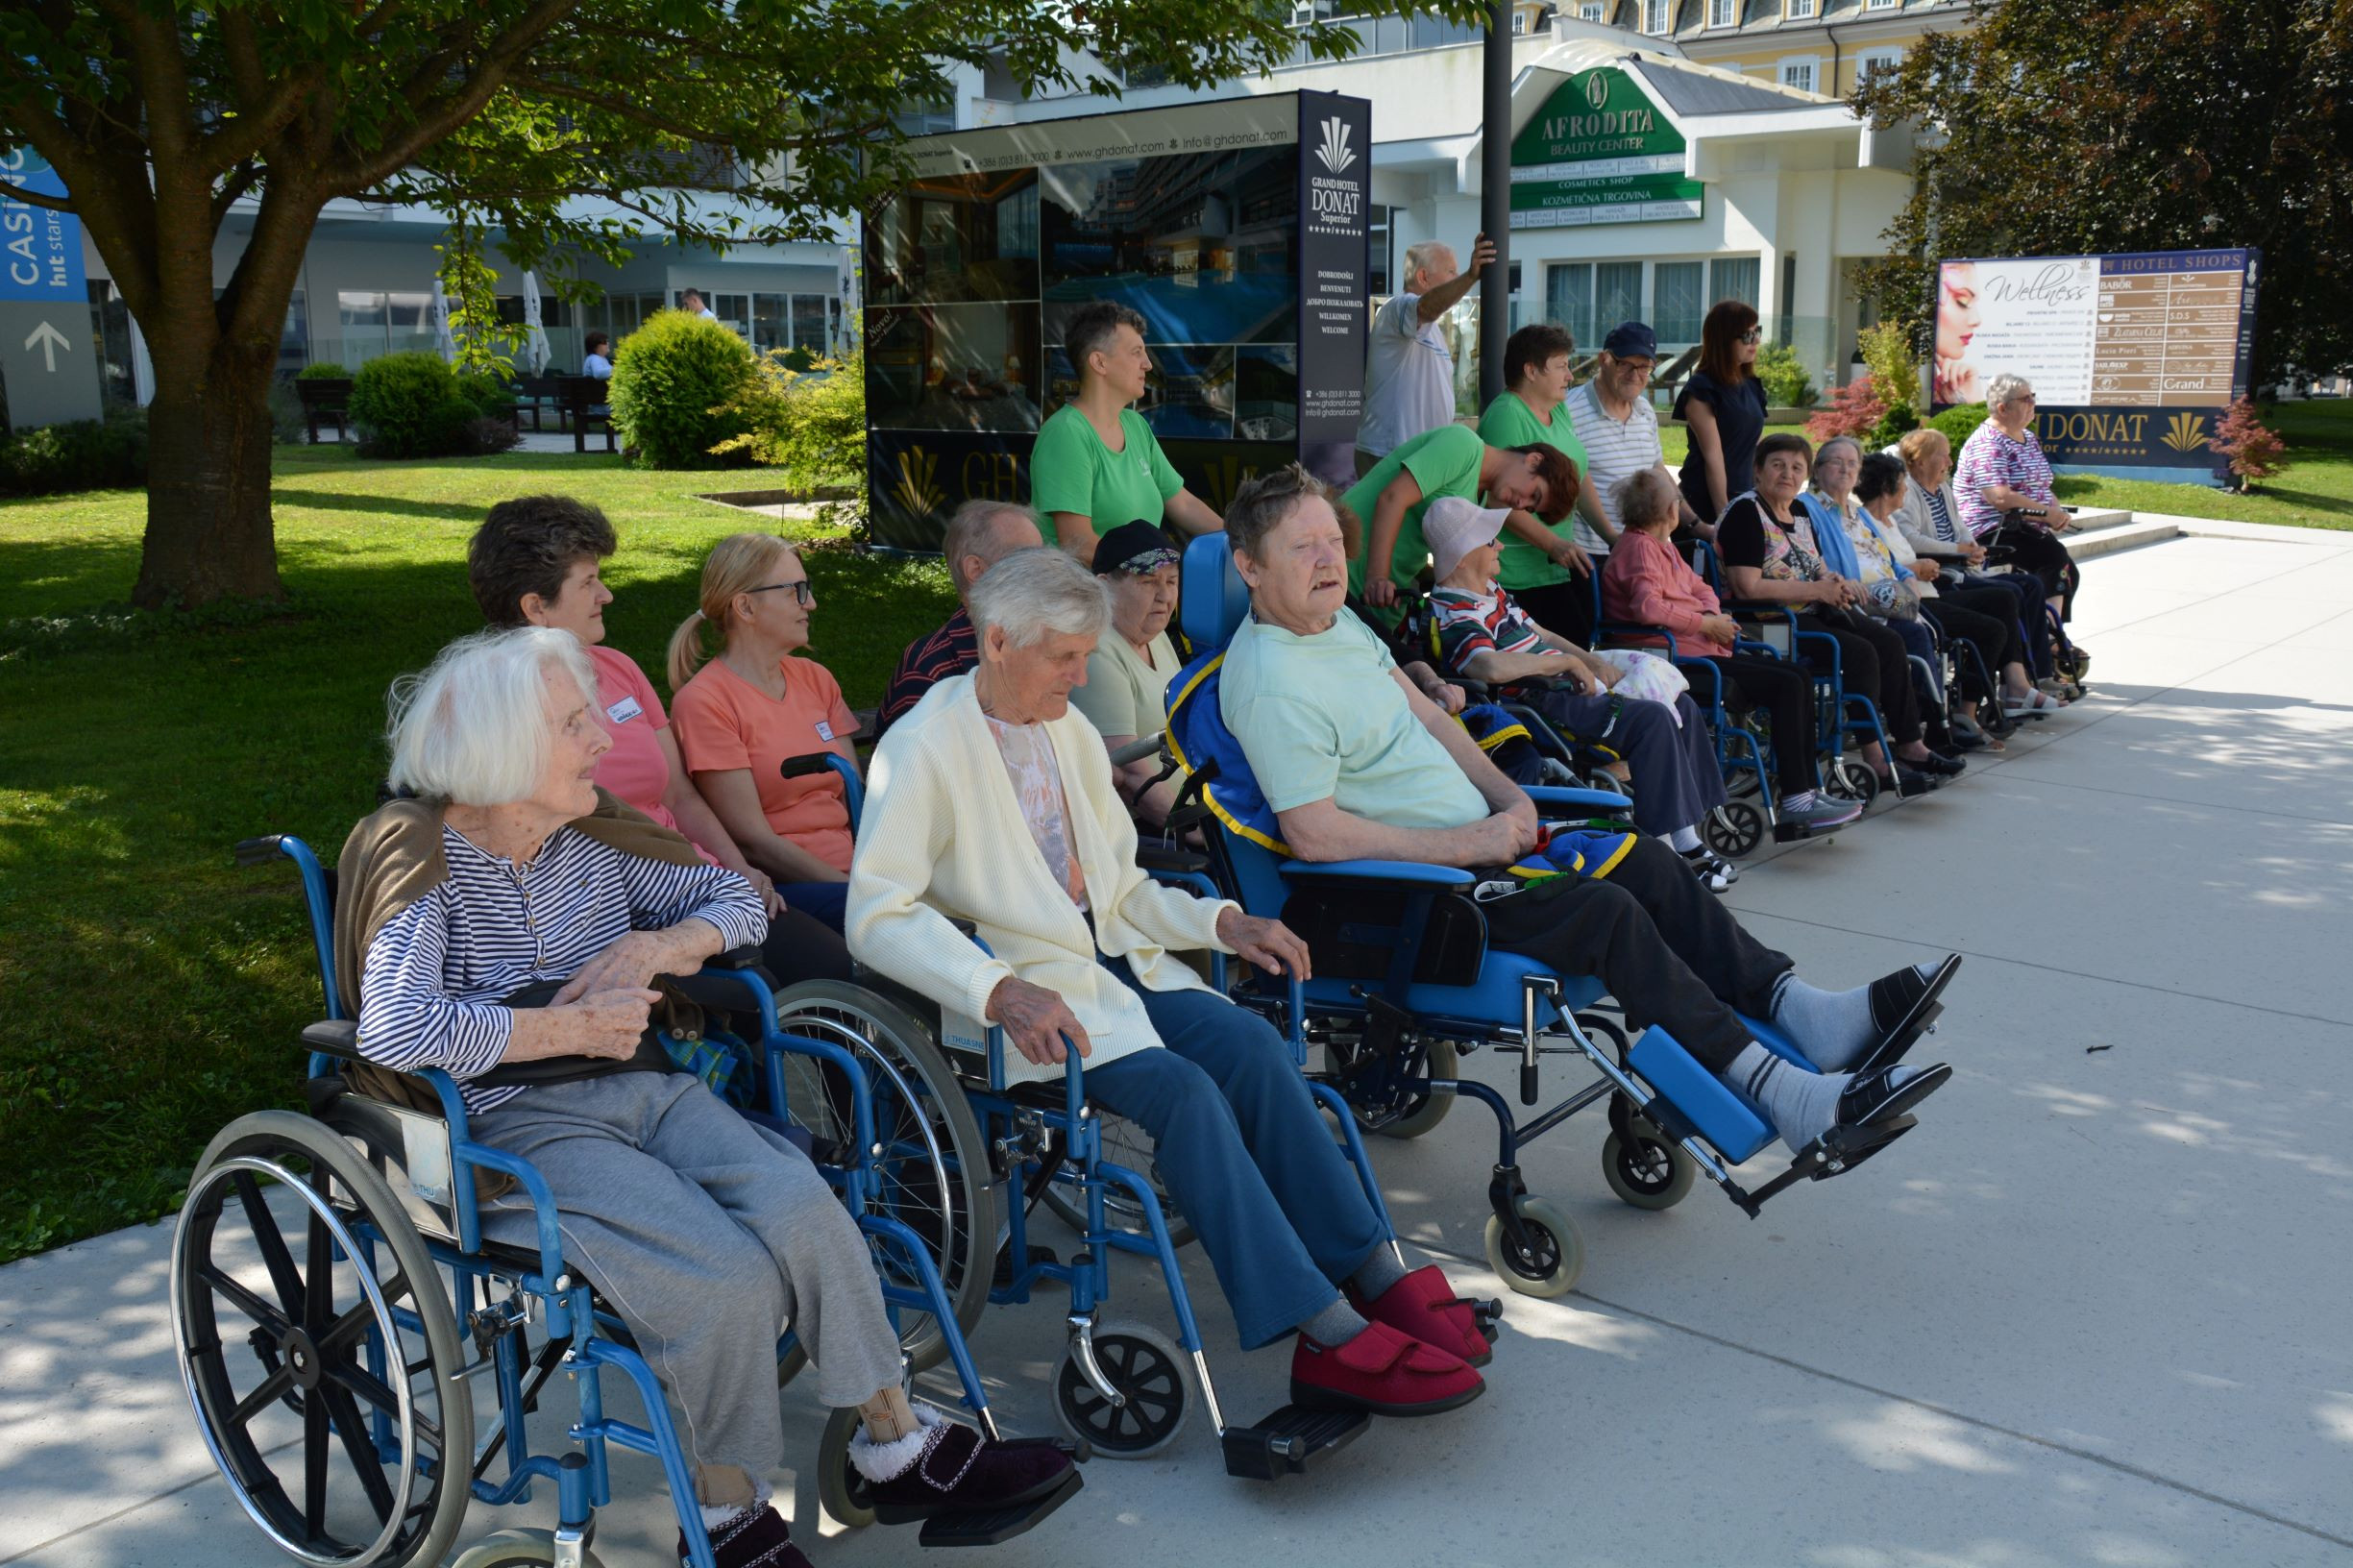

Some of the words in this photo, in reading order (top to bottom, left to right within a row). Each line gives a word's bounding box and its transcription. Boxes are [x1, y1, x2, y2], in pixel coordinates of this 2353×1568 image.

[1542, 110, 1654, 140] AFRODITA
[1067, 141, 1164, 159] www.ghdonat.com
[1551, 141, 1595, 156] BEAUTY
[1599, 137, 1644, 151] CENTER
[1311, 177, 1336, 189] GRAND
[1336, 180, 1360, 191] HOTEL
[1558, 179, 1606, 189] COSMETICS
[1609, 177, 1633, 185] SHOP
[1311, 188, 1360, 214] DONAT
[1542, 193, 1600, 207] KOZMETIČNA
[1604, 190, 1652, 203] TRGOVINA
[1320, 210, 1352, 225] Superior
[46, 208, 63, 251] stars
[2121, 257, 2177, 271] HOTEL
[2185, 254, 2242, 268] SHOPS
[49, 256, 67, 287] hit
[1320, 284, 1351, 293] BENVENUTI
[1984, 262, 2091, 306] Wellness
[1321, 326, 1349, 334] WELCOME
[2164, 378, 2205, 390] Grand
[1306, 400, 1361, 408] www.ghdonat.com
[2047, 413, 2148, 442] DONAT
[952, 1035, 985, 1048] THUASNE
